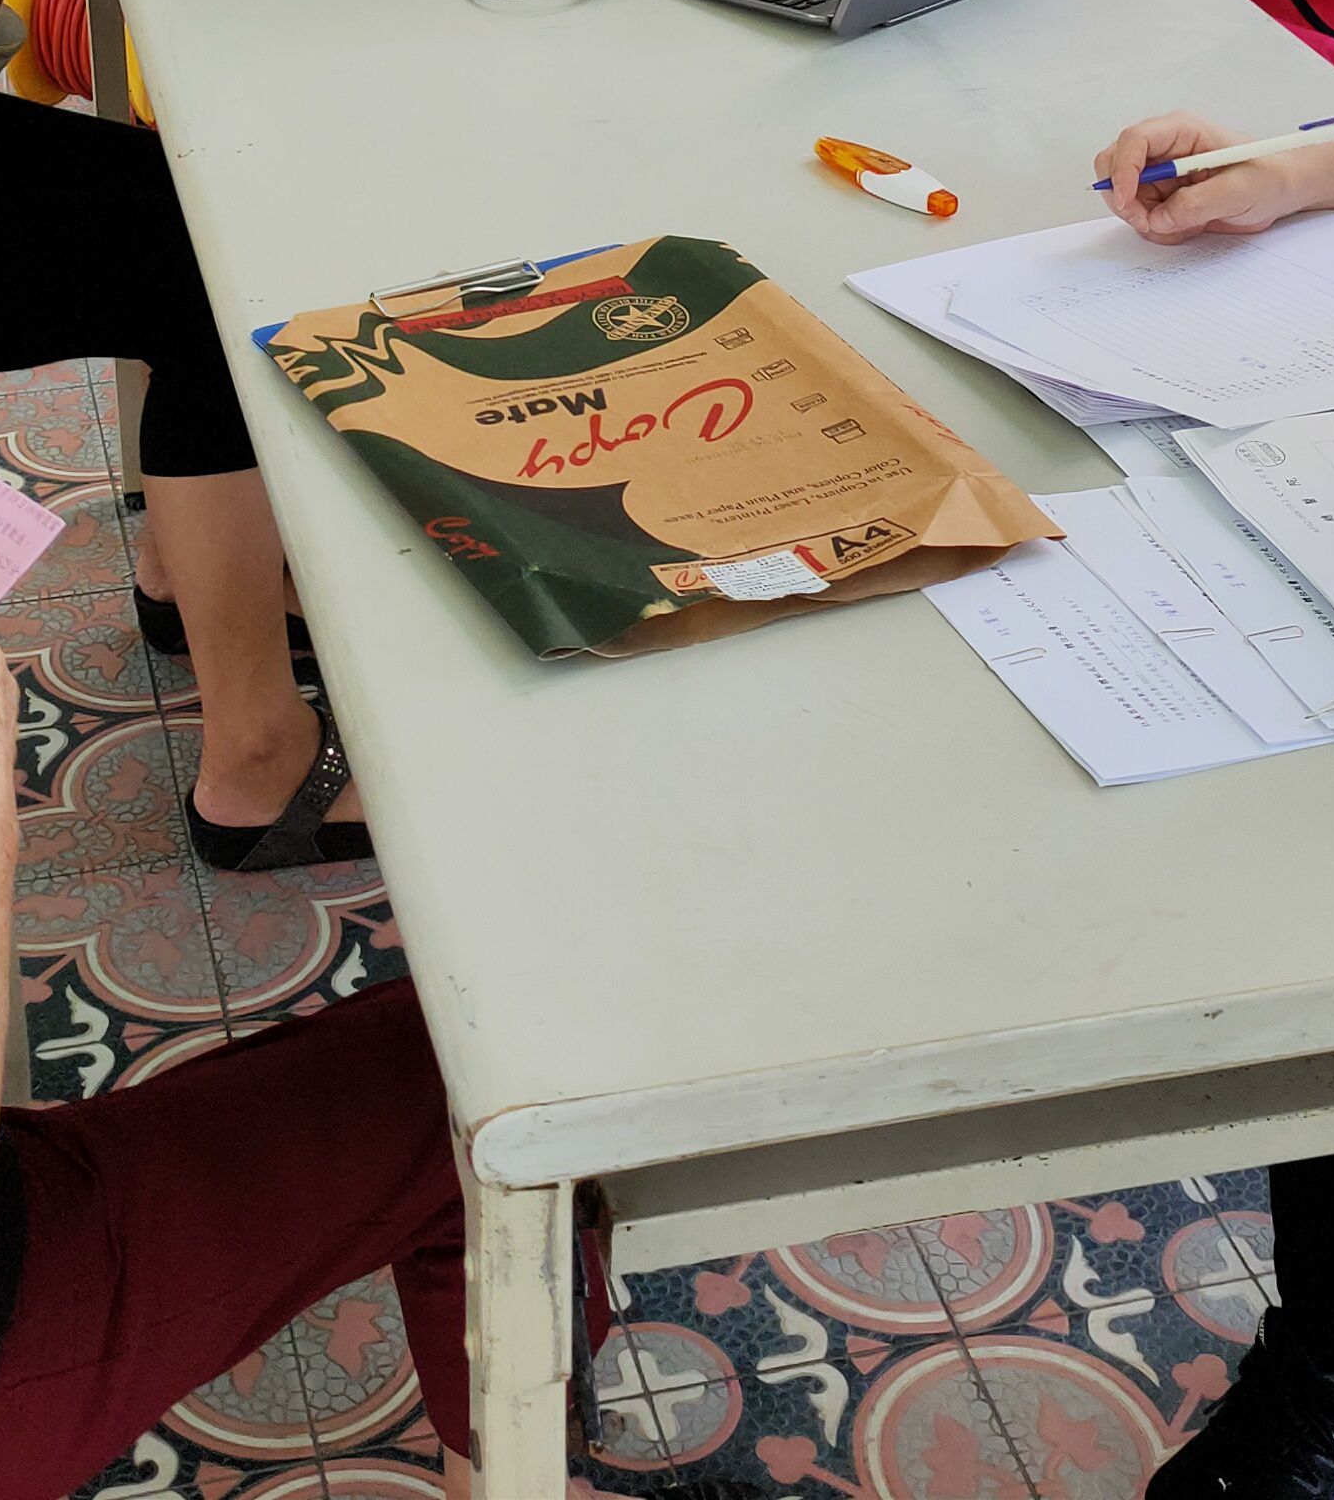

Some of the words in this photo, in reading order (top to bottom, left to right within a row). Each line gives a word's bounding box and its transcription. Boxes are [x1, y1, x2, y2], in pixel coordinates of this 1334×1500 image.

[475, 386, 607, 426] Mate
[521, 380, 753, 477] Copy
[856, 456, 906, 475] Color
[803, 470, 865, 491] Copiers,
[743, 492, 783, 507] Plain
[778, 485, 809, 498] and
[702, 500, 746, 517] Paper
[769, 496, 812, 513] Laser
[832, 516, 896, 558] A4
[834, 551, 864, 564] 500
